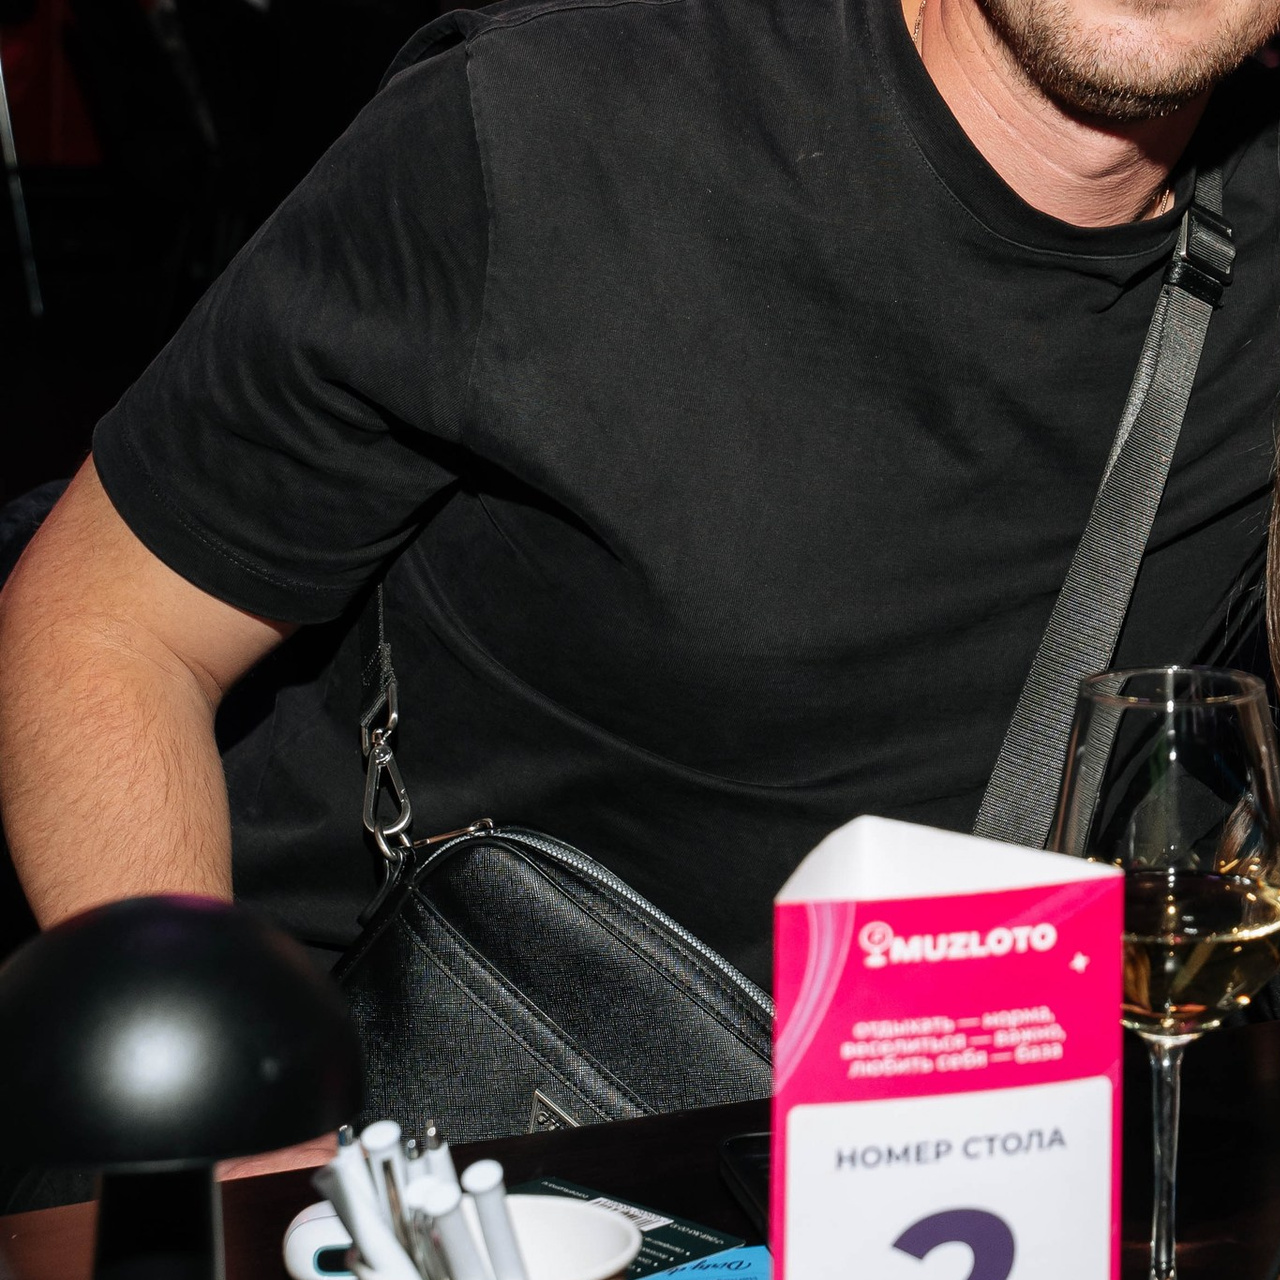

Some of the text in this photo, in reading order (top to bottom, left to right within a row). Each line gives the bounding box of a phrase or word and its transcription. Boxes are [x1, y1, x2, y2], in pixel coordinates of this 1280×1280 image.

[889, 922, 1058, 964] MUZLOTO
[852, 1015, 956, 1040] отдыхать
[840, 1033, 967, 1061] веселиться
[847, 1055, 934, 1080] любить
[935, 1047, 989, 1072] себя
[1014, 1042, 1064, 1065] база
[835, 1127, 1067, 1170] НОМЕР СТОЛА
